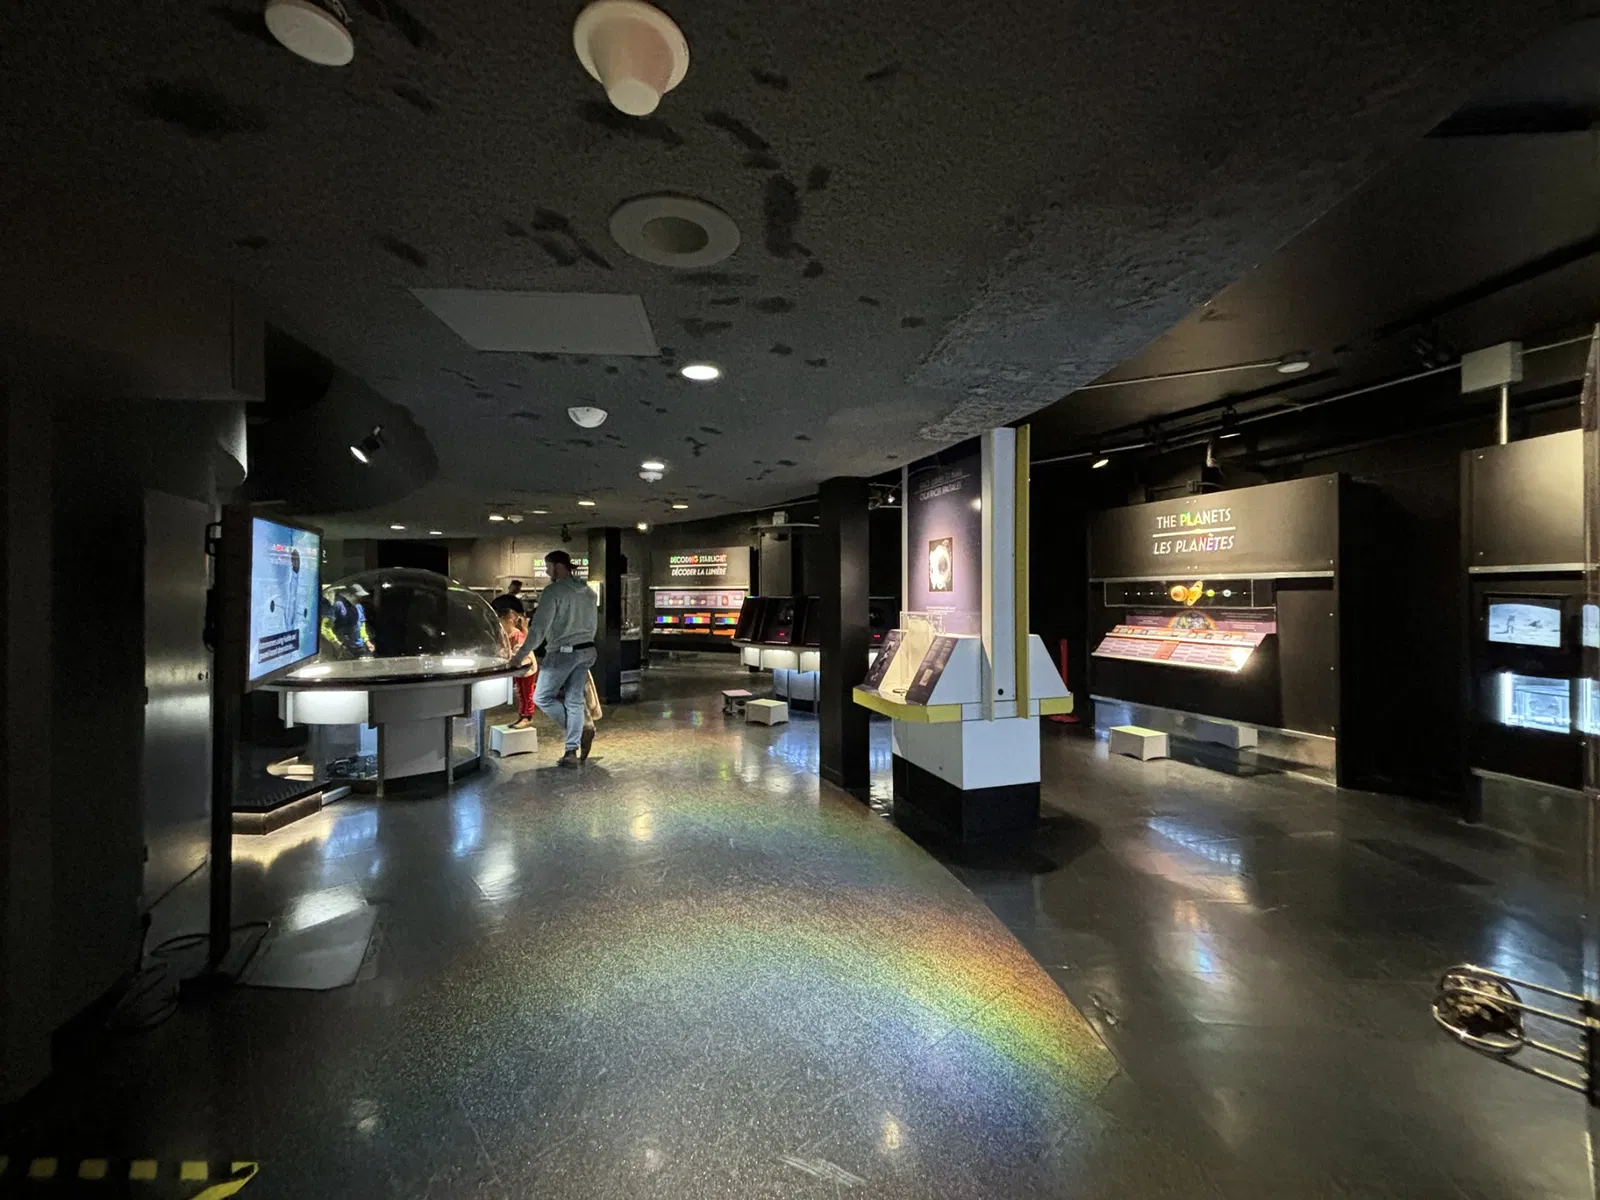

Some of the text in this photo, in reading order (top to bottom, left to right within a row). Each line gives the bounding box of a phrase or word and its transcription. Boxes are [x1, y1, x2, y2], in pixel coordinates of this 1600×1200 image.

[1156, 508, 1231, 529] THE PLANETS
[1153, 541, 1172, 555] LES
[670, 554, 727, 564] DECODING STARLIGHT
[671, 567, 697, 576] DÉCODER
[705, 566, 727, 576] LUMIÈRE
